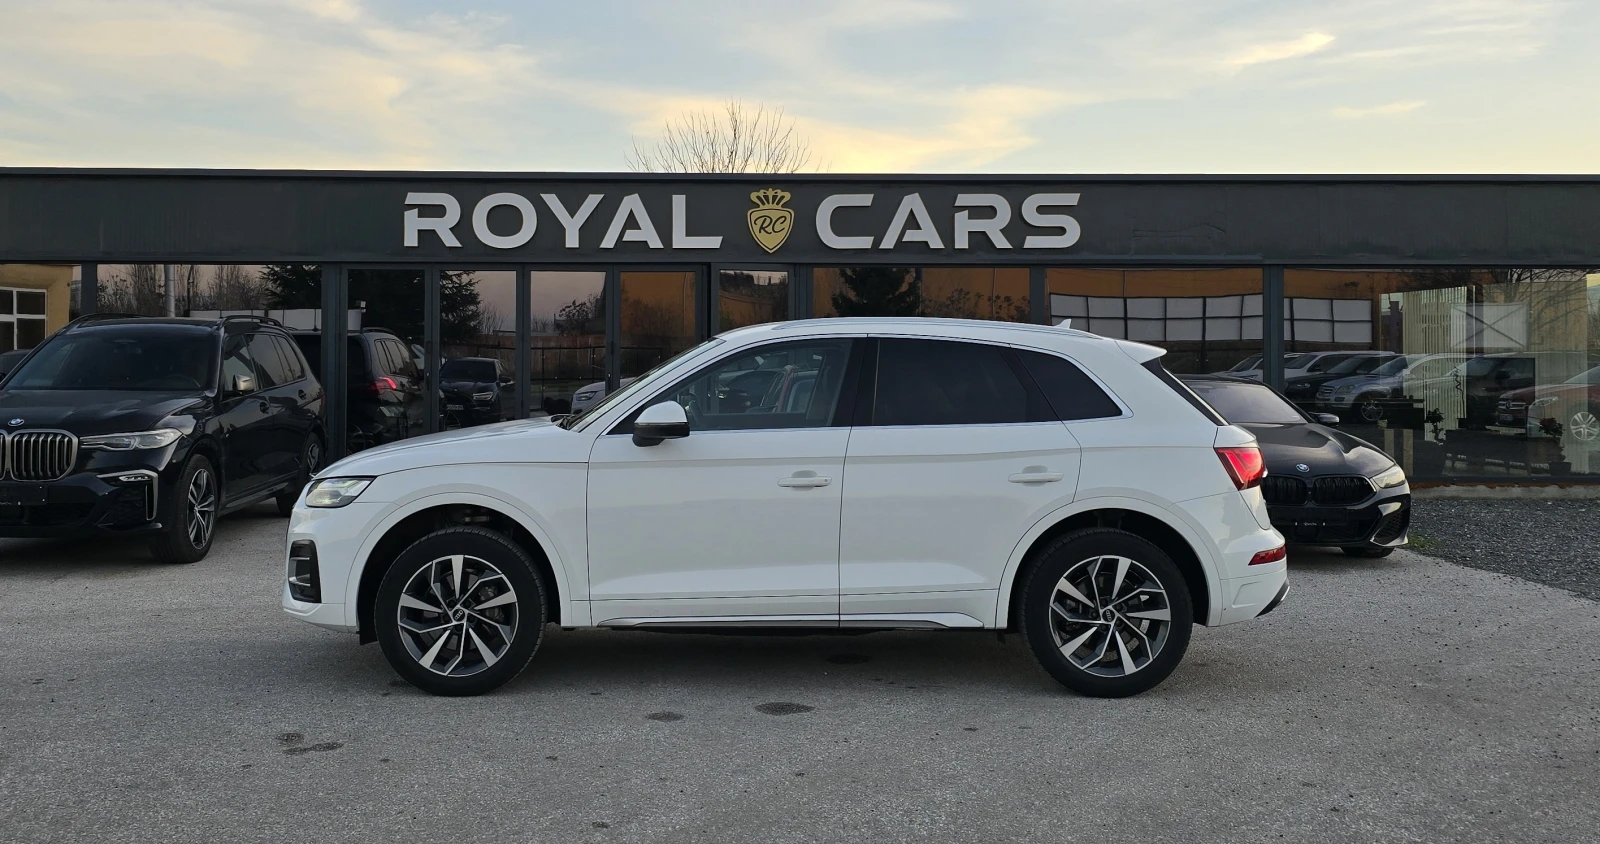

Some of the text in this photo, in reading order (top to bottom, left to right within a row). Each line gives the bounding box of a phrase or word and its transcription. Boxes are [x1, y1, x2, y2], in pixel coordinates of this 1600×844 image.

[403, 192, 1081, 250] ROYAL CARS
[753, 214, 787, 235] RC
